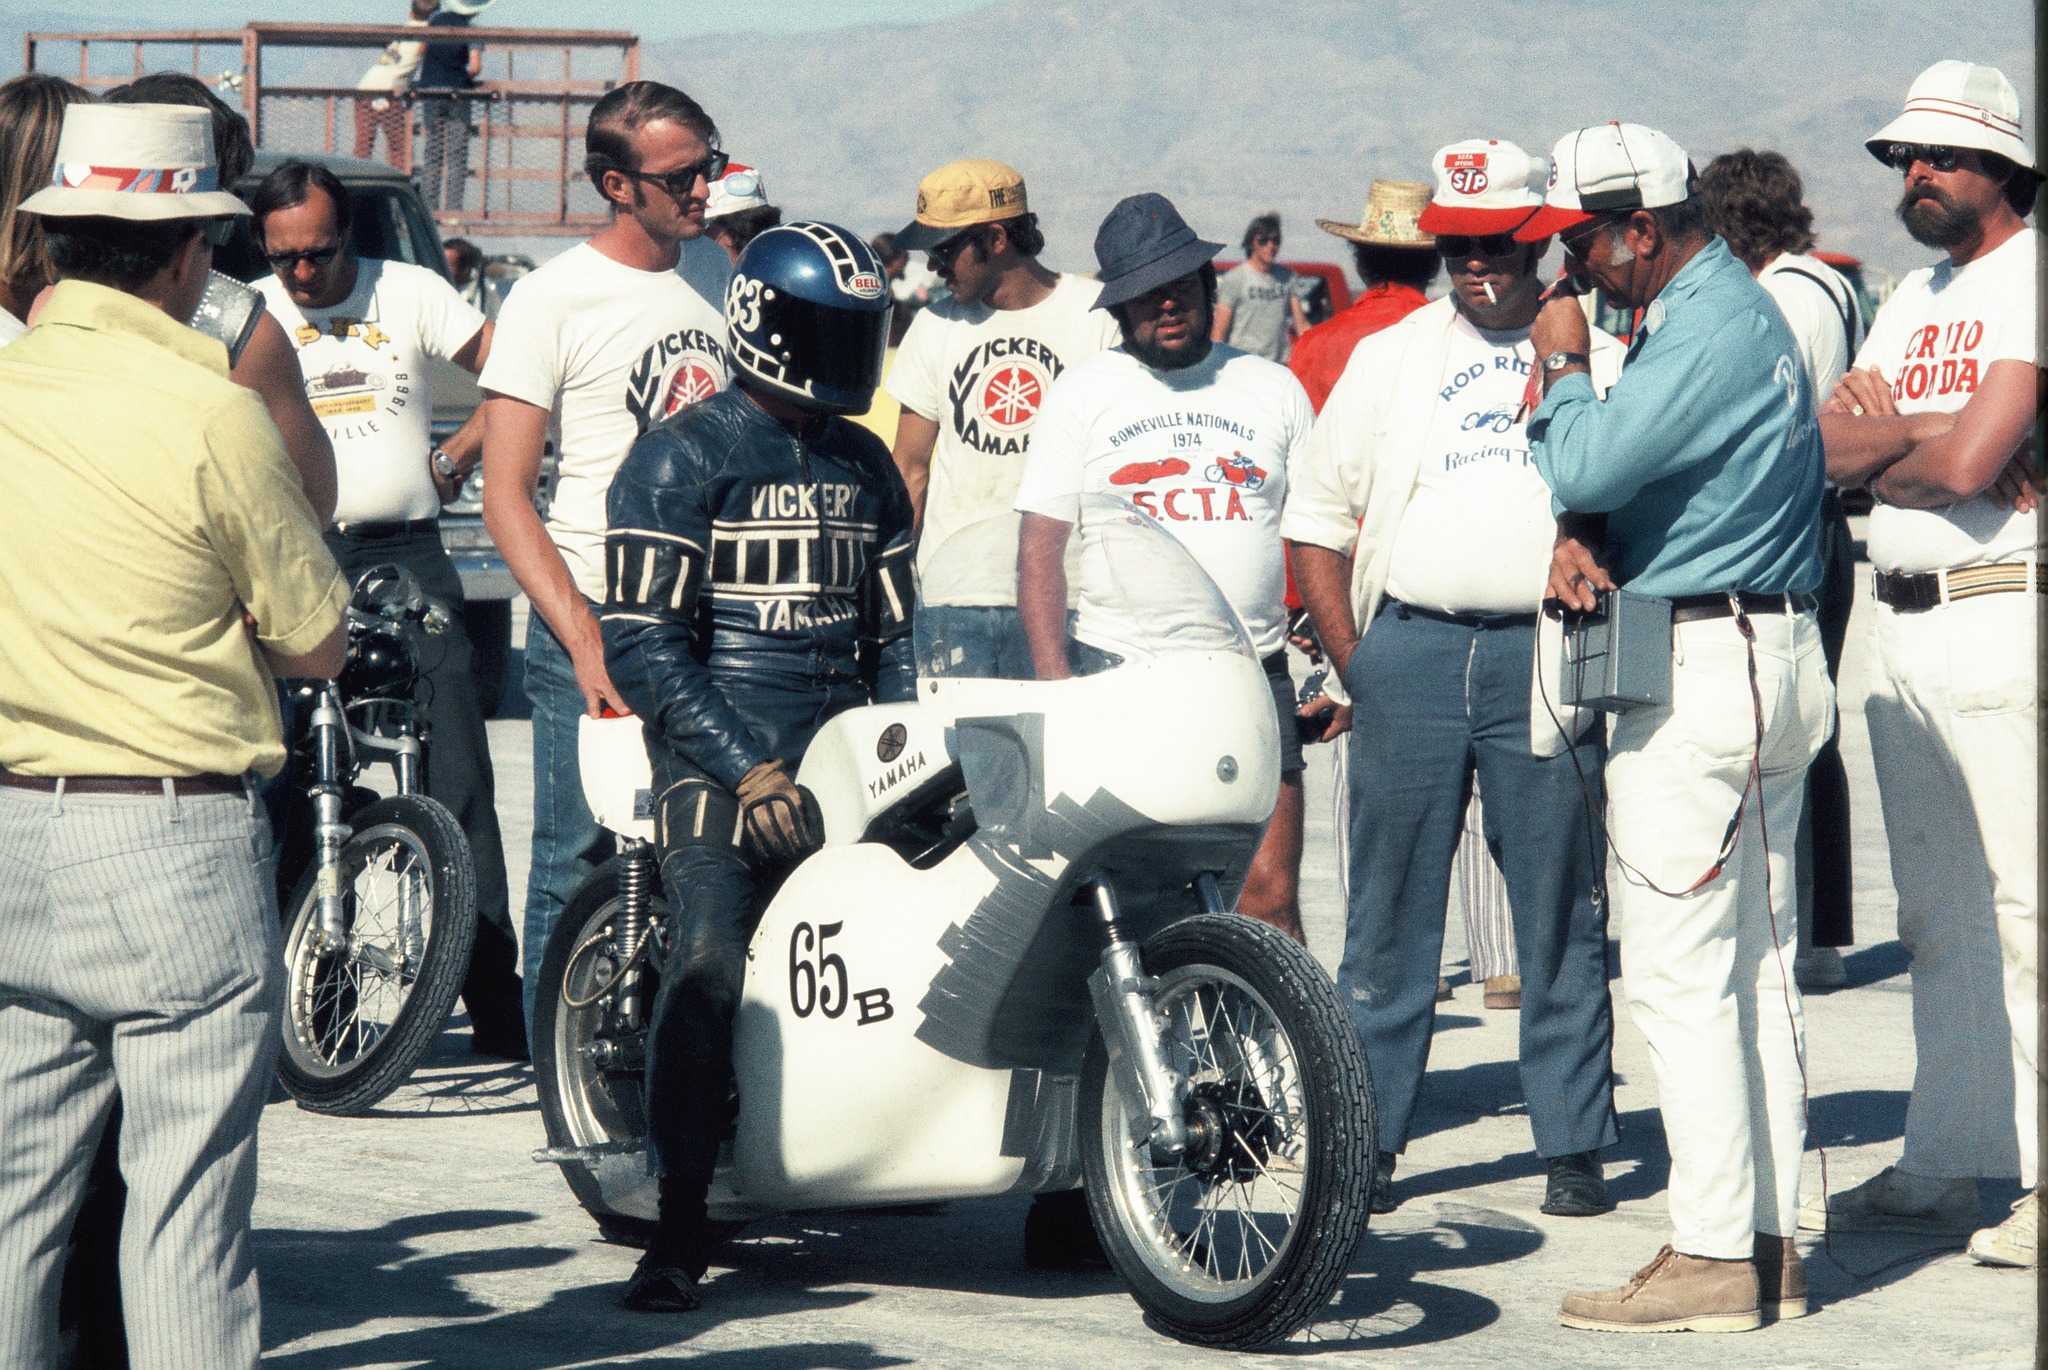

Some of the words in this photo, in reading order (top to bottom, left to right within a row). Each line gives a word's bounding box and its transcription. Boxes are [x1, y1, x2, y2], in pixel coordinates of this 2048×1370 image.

[988, 187, 1005, 209] THE
[1452, 168, 1487, 192] STP
[855, 278, 880, 288] BELL
[726, 274, 764, 332] 83
[953, 337, 1065, 391] VICKERY
[386, 373, 409, 416] 1968
[1439, 363, 1485, 402] ROD
[324, 420, 380, 439] ILLE
[1109, 411, 1183, 448] BONNEVILLE
[1186, 412, 1256, 442] NATIONALS
[1172, 433, 1203, 448] 1974
[1445, 444, 1511, 471] Racing
[751, 483, 862, 519] VICKERY
[1132, 487, 1254, 522] S.C.T.A.
[868, 750, 927, 799] YAMAHA
[789, 919, 849, 1020] 65
[852, 987, 894, 1027] B
